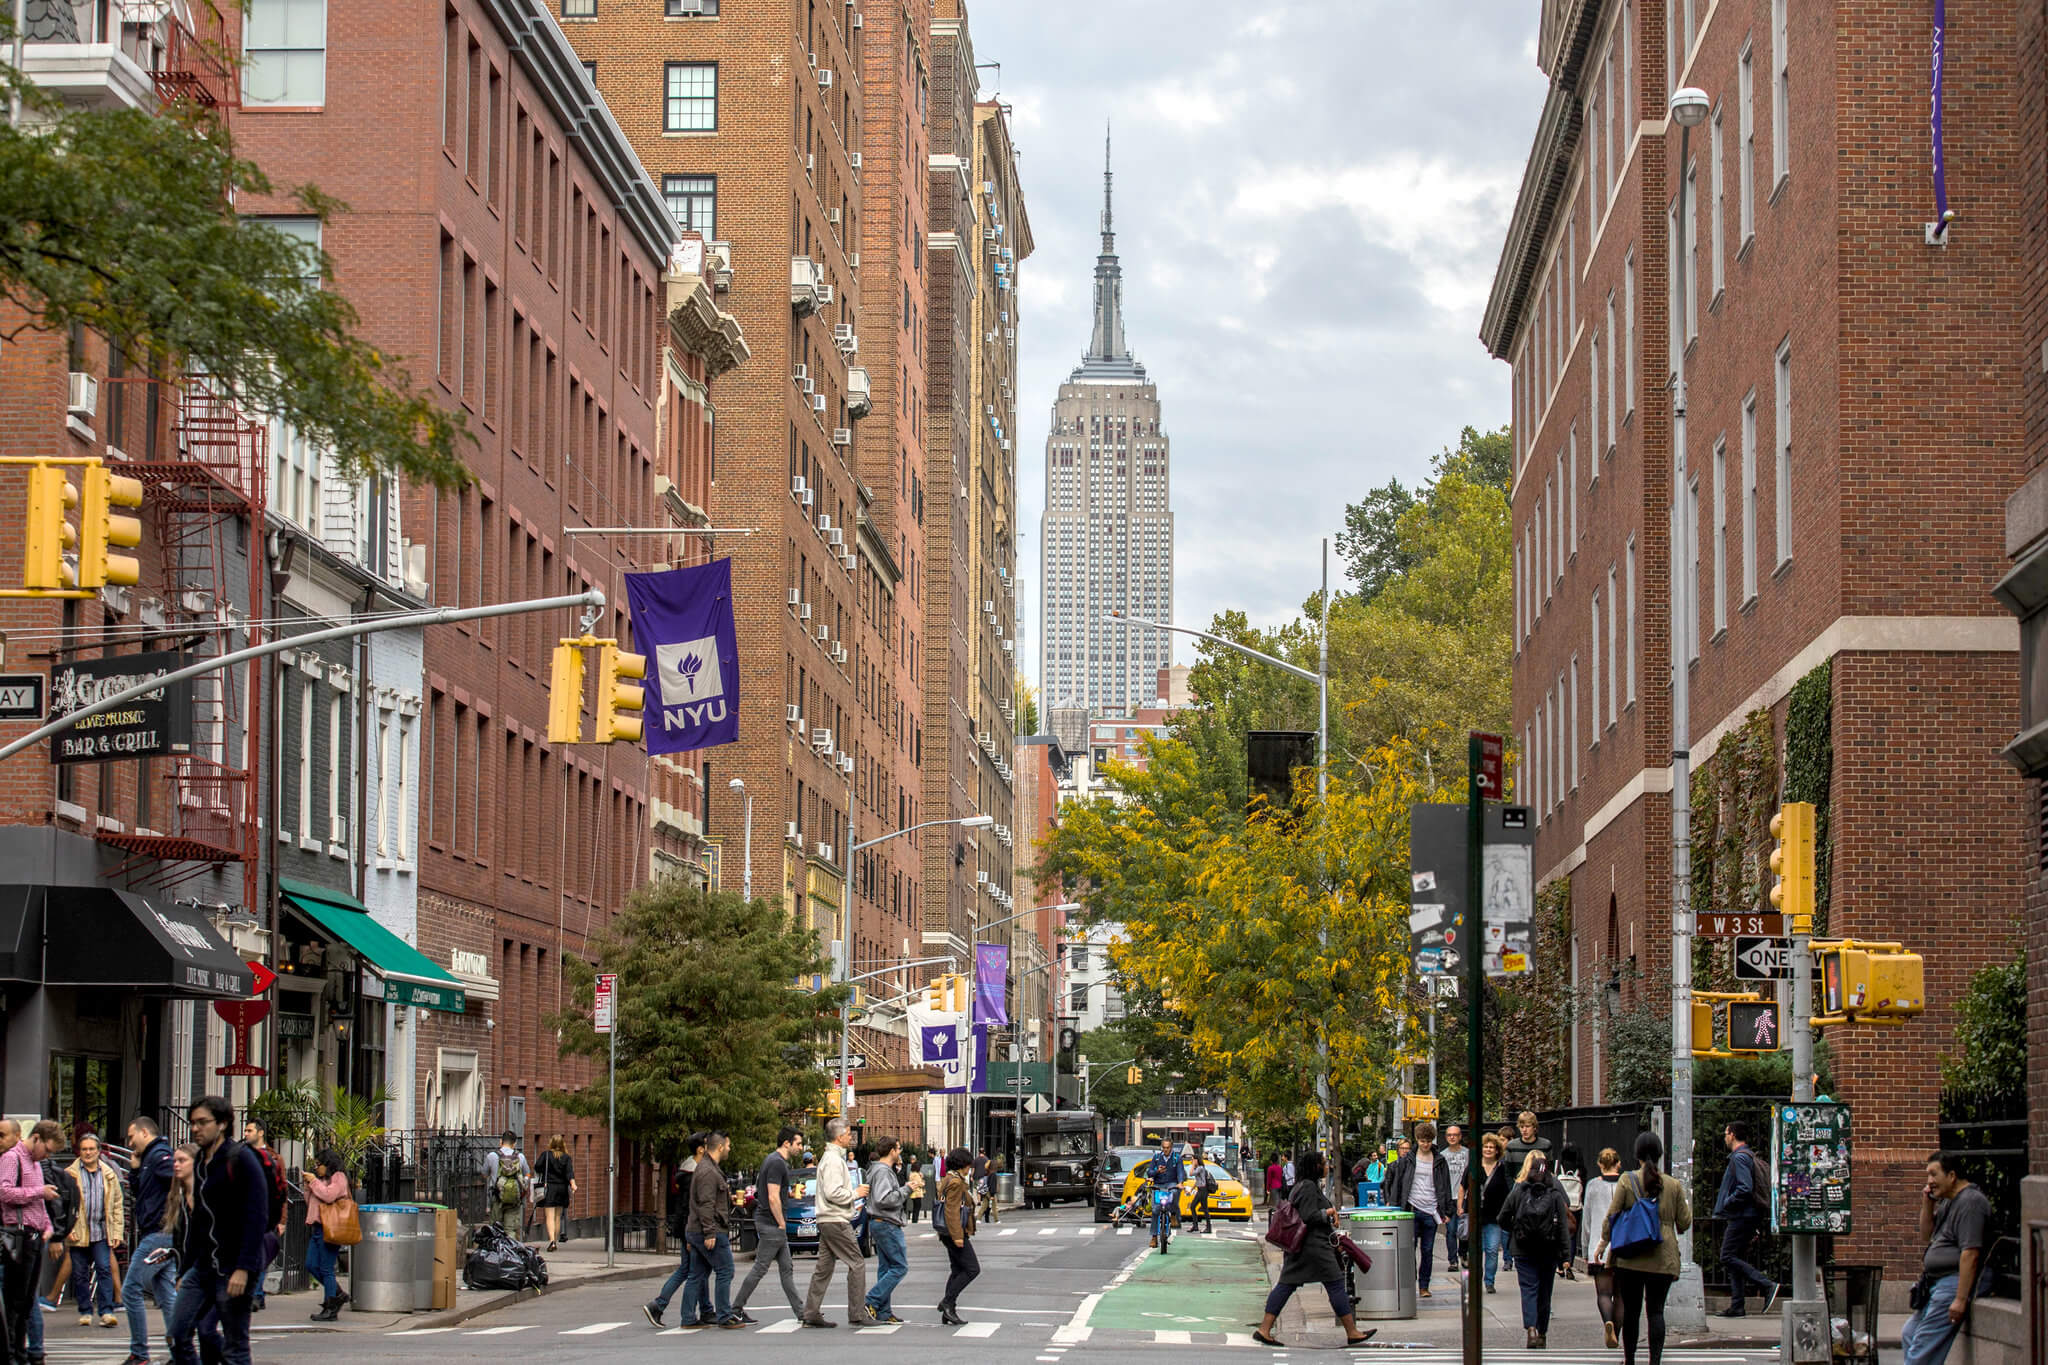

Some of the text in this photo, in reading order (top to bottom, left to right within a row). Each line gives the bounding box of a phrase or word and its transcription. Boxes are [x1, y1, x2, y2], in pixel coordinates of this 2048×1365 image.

[663, 699, 727, 731] NYU
[62, 731, 160, 756] BAR & GRILL
[1714, 917, 1764, 934] W 3 St
[1750, 950, 1788, 966] ONE
